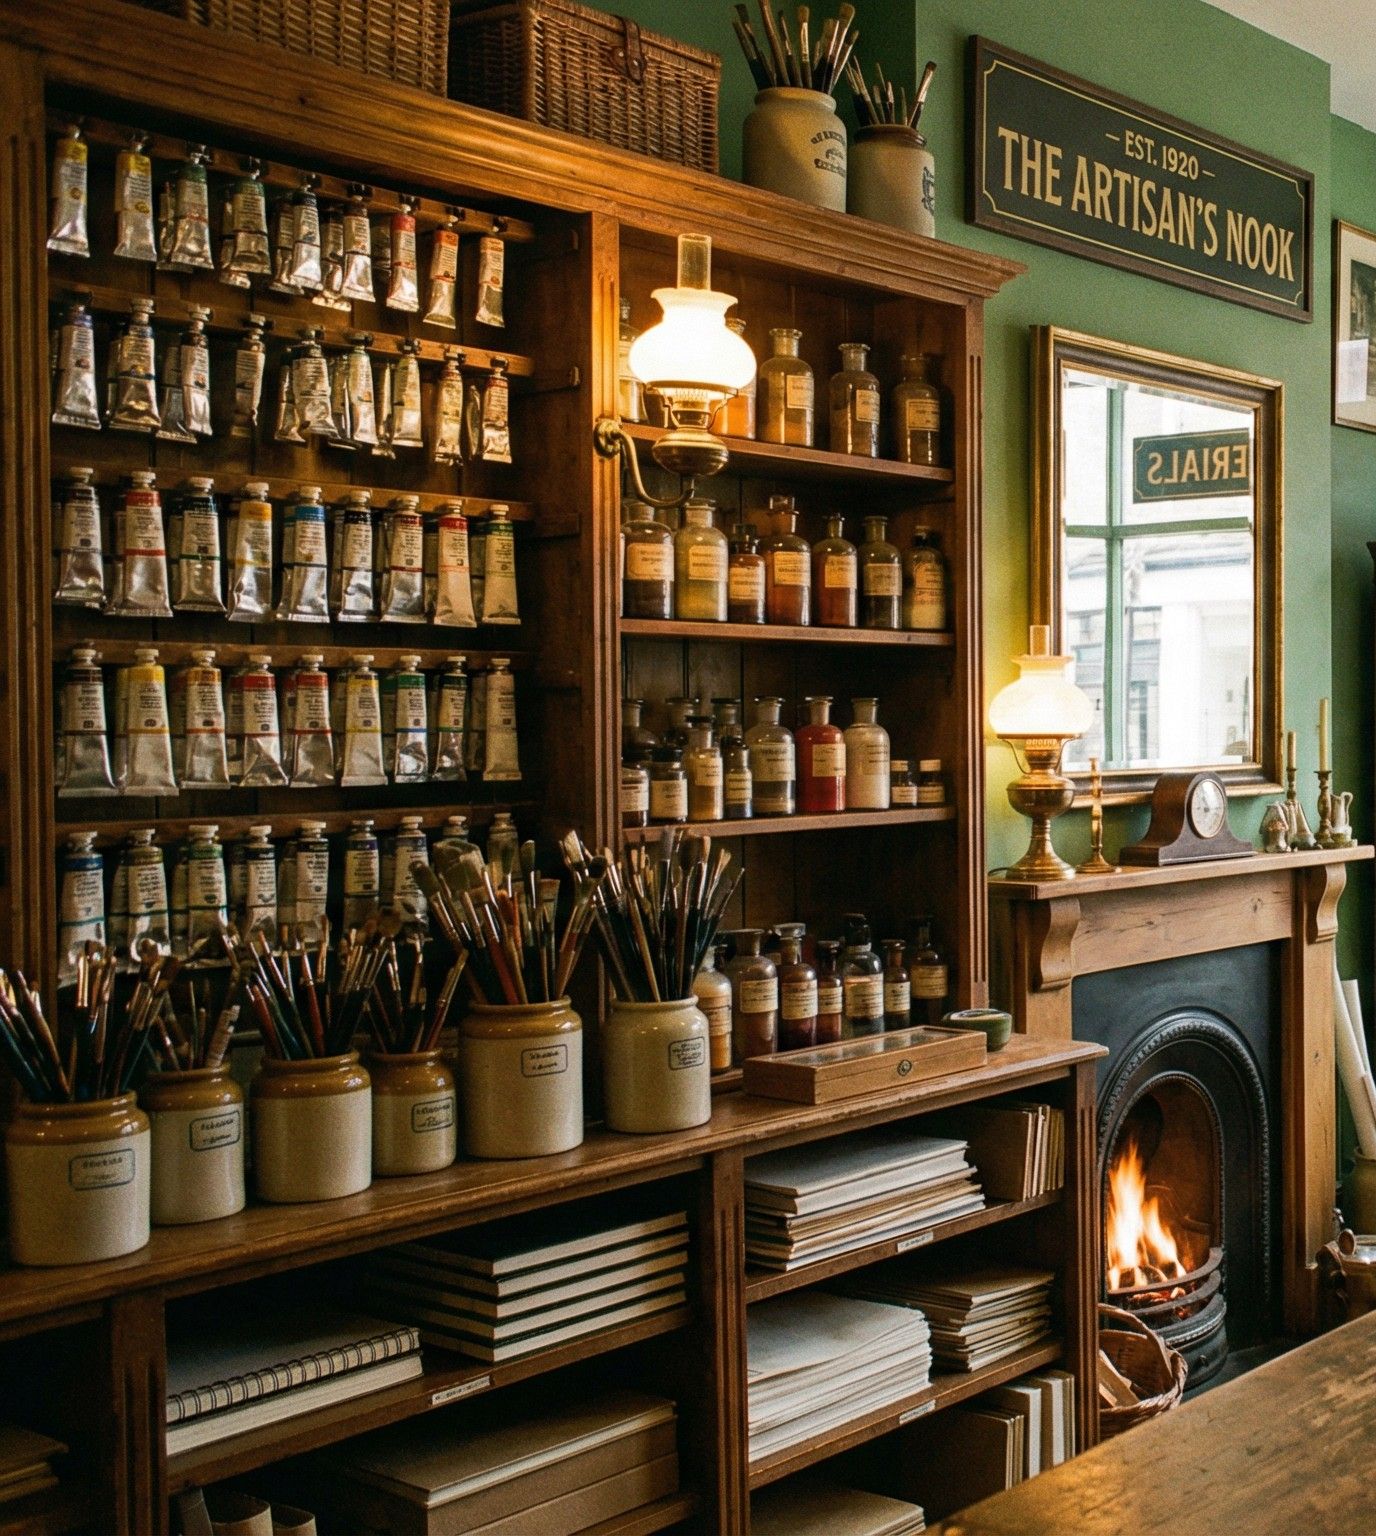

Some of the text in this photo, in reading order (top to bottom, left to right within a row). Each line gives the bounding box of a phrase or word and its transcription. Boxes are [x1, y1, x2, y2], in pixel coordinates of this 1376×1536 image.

[998, 126, 1063, 207] THE
[1071, 155, 1218, 257] ARTISAN'S
[1226, 209, 1295, 283] NOOK
[1124, 129, 1199, 181] EST. 1920
